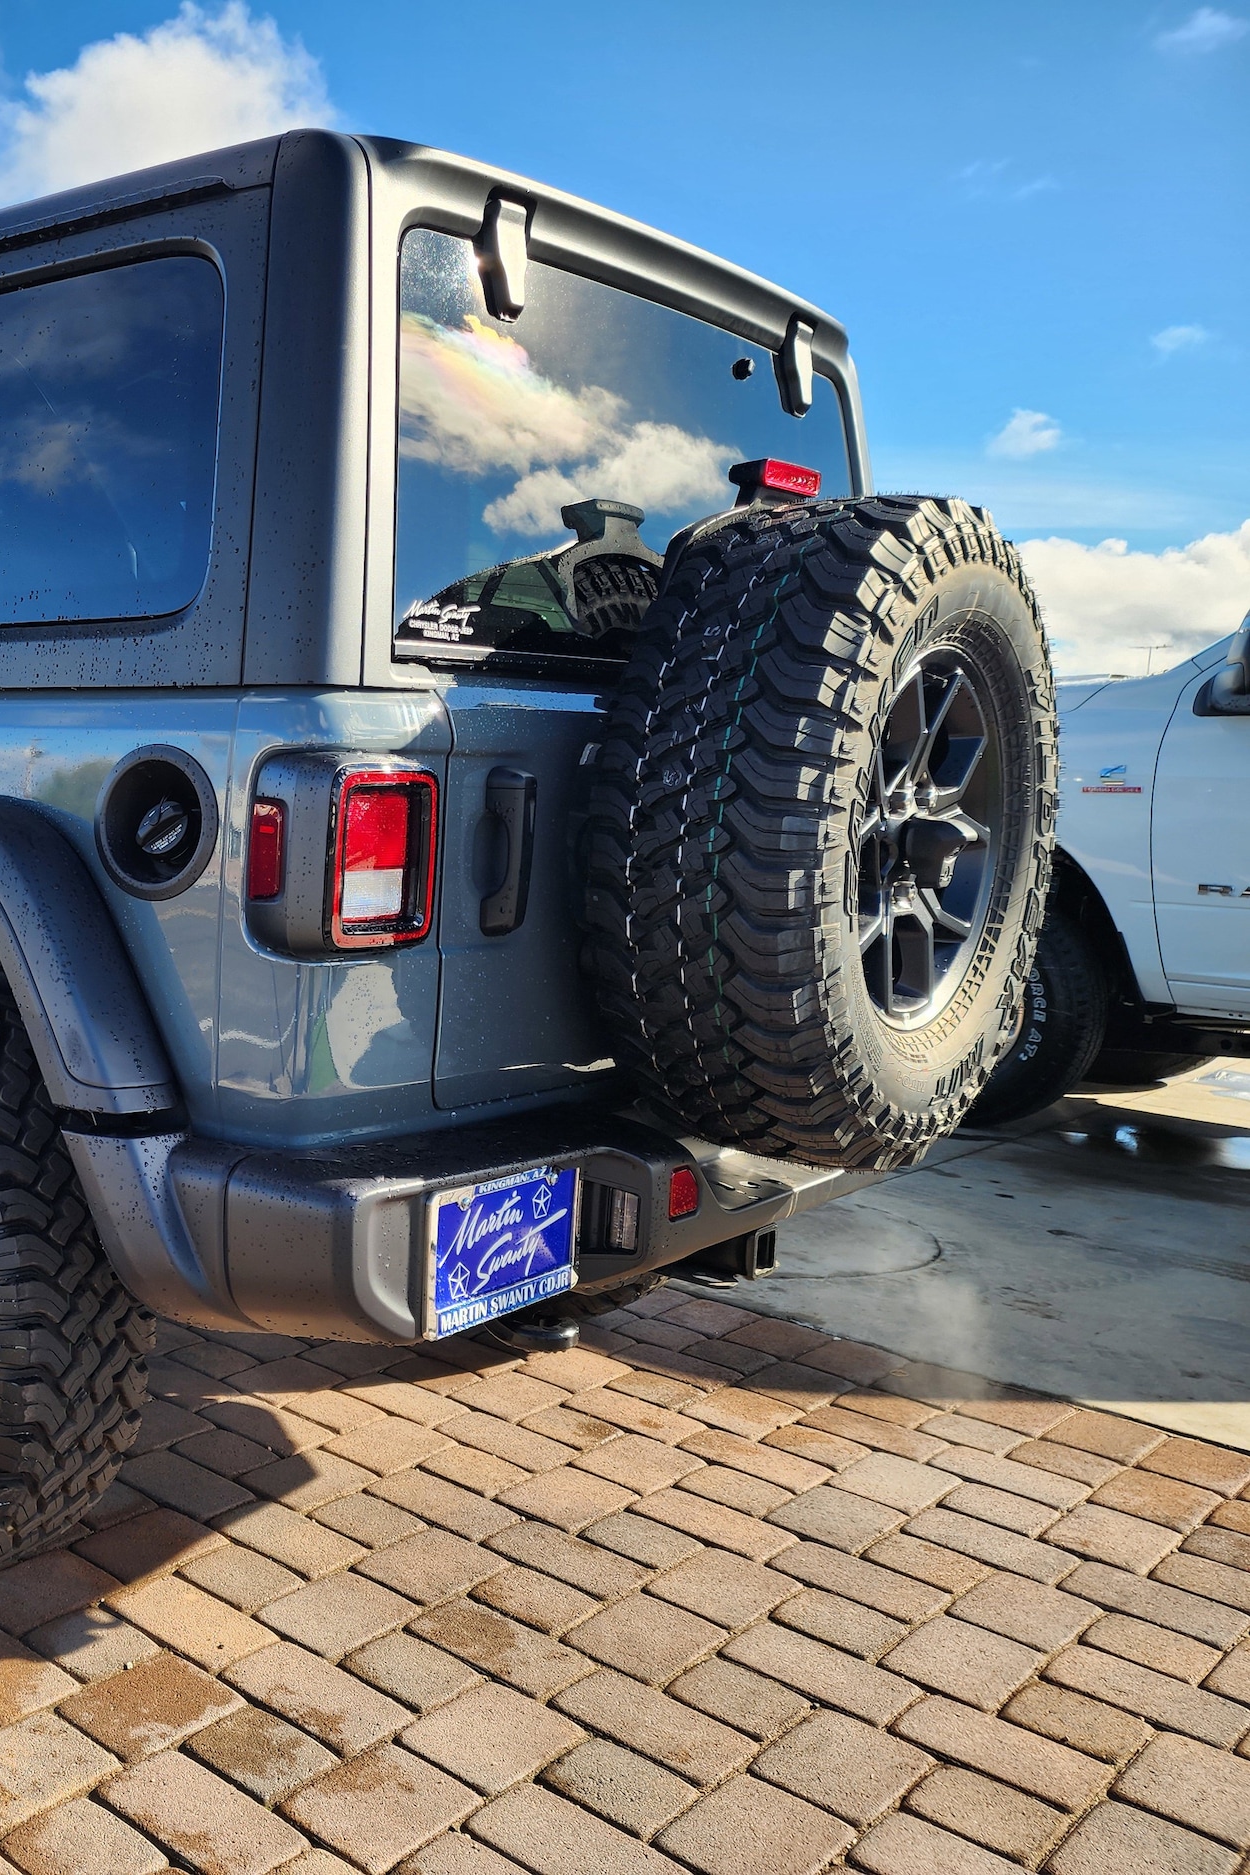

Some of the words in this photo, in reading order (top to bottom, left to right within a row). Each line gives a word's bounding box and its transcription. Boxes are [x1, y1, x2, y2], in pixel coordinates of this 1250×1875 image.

[403, 600, 441, 619] Martin
[438, 604, 481, 627] Swanty
[409, 619, 438, 630] CHRYSLER
[451, 633, 460, 641] AZ
[532, 1165, 548, 1180] AZ
[438, 1190, 524, 1268] Martin
[471, 1208, 568, 1294] Swanty
[441, 1300, 488, 1332] MARTIN
[490, 1284, 538, 1313] SWANTY
[539, 1270, 570, 1295] CDJR
